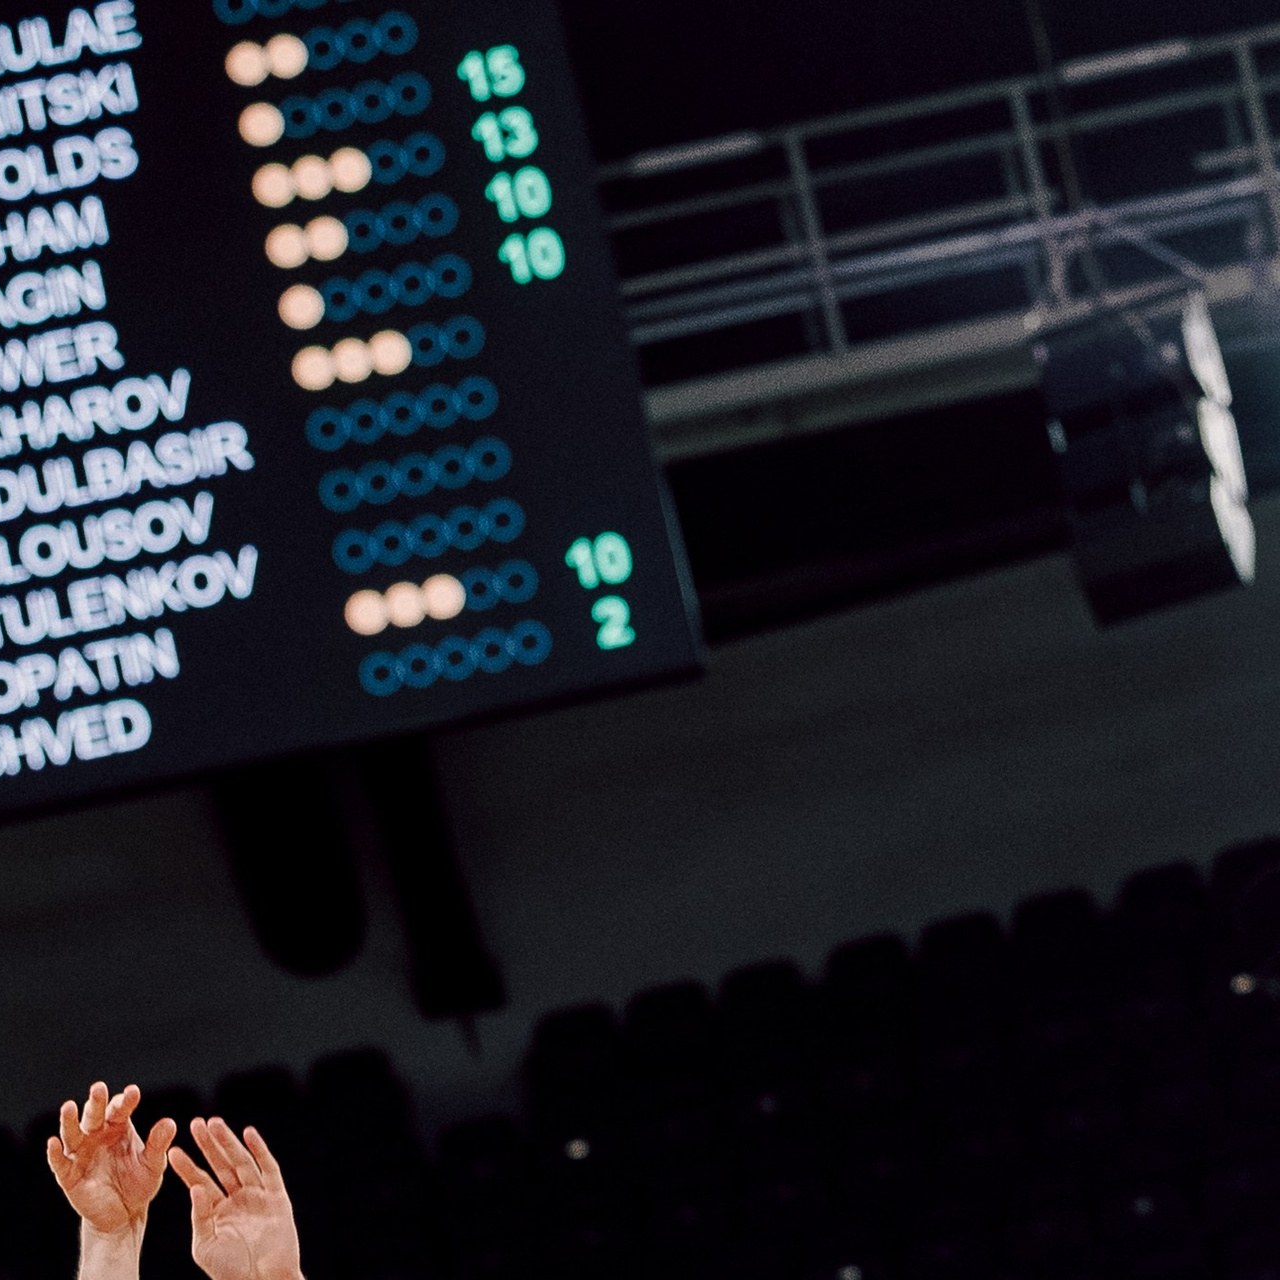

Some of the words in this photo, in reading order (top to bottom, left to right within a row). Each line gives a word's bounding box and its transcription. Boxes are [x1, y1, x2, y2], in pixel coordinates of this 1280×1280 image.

[456, 44, 526, 102] 15
[471, 106, 540, 163] 13
[485, 165, 553, 223] 10
[498, 226, 566, 286] 10
[564, 530, 632, 589] 10
[591, 596, 636, 651] 2
